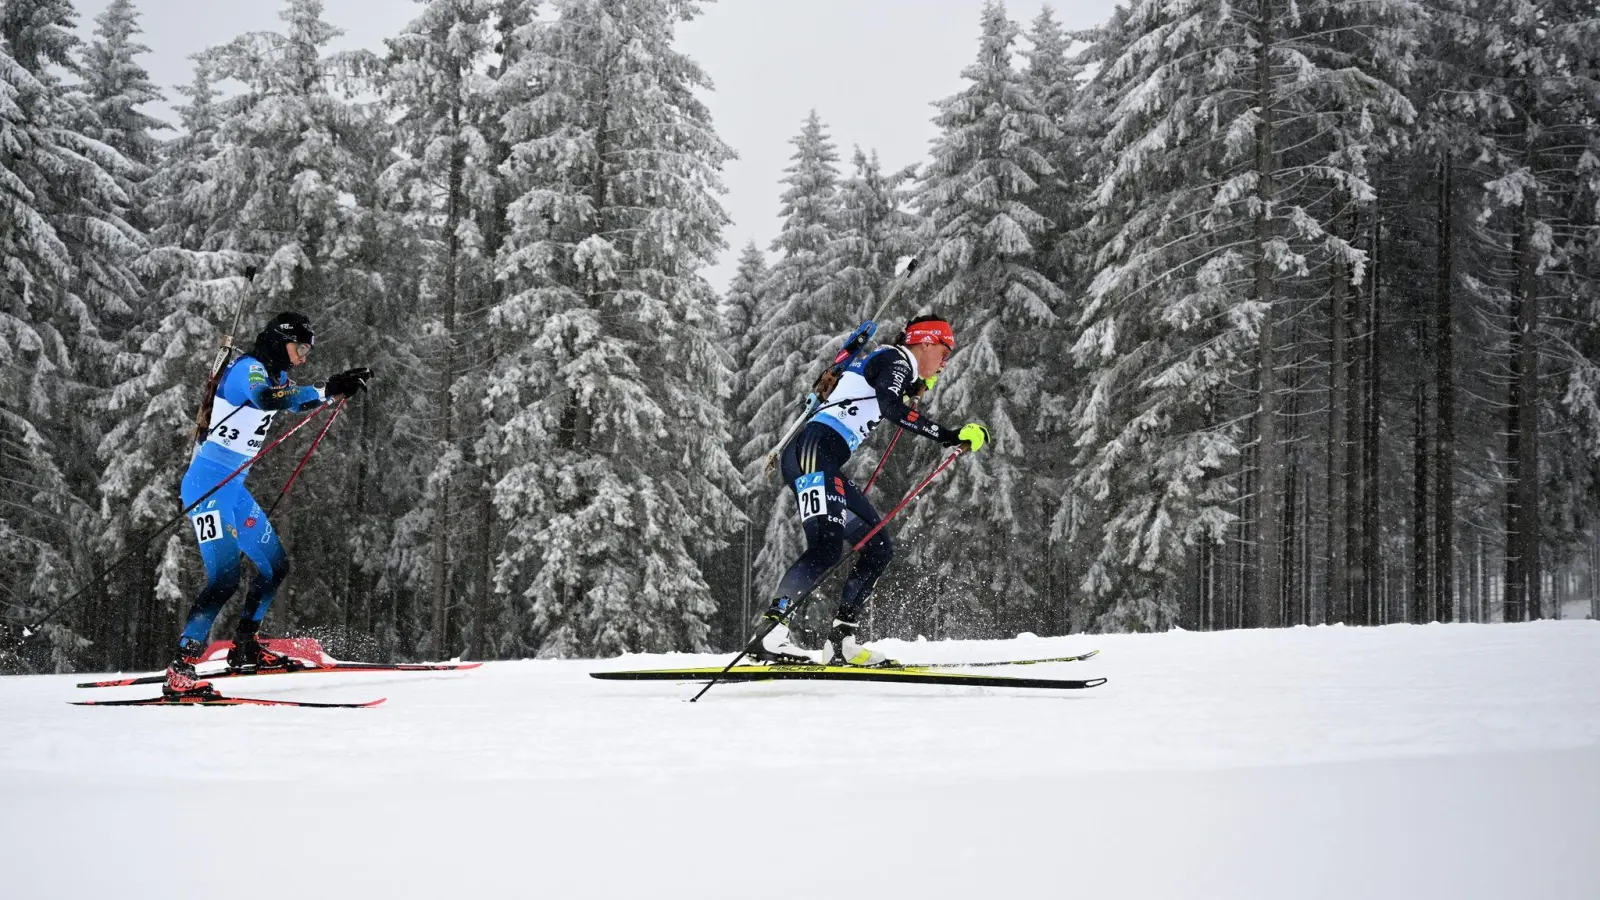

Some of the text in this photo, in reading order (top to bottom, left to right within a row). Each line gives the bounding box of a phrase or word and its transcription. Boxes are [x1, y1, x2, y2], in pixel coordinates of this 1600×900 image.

[271, 388, 301, 399] somfy
[888, 370, 906, 396] Audi
[218, 425, 240, 441] 23
[802, 489, 821, 518] 26
[196, 514, 217, 542] 23
